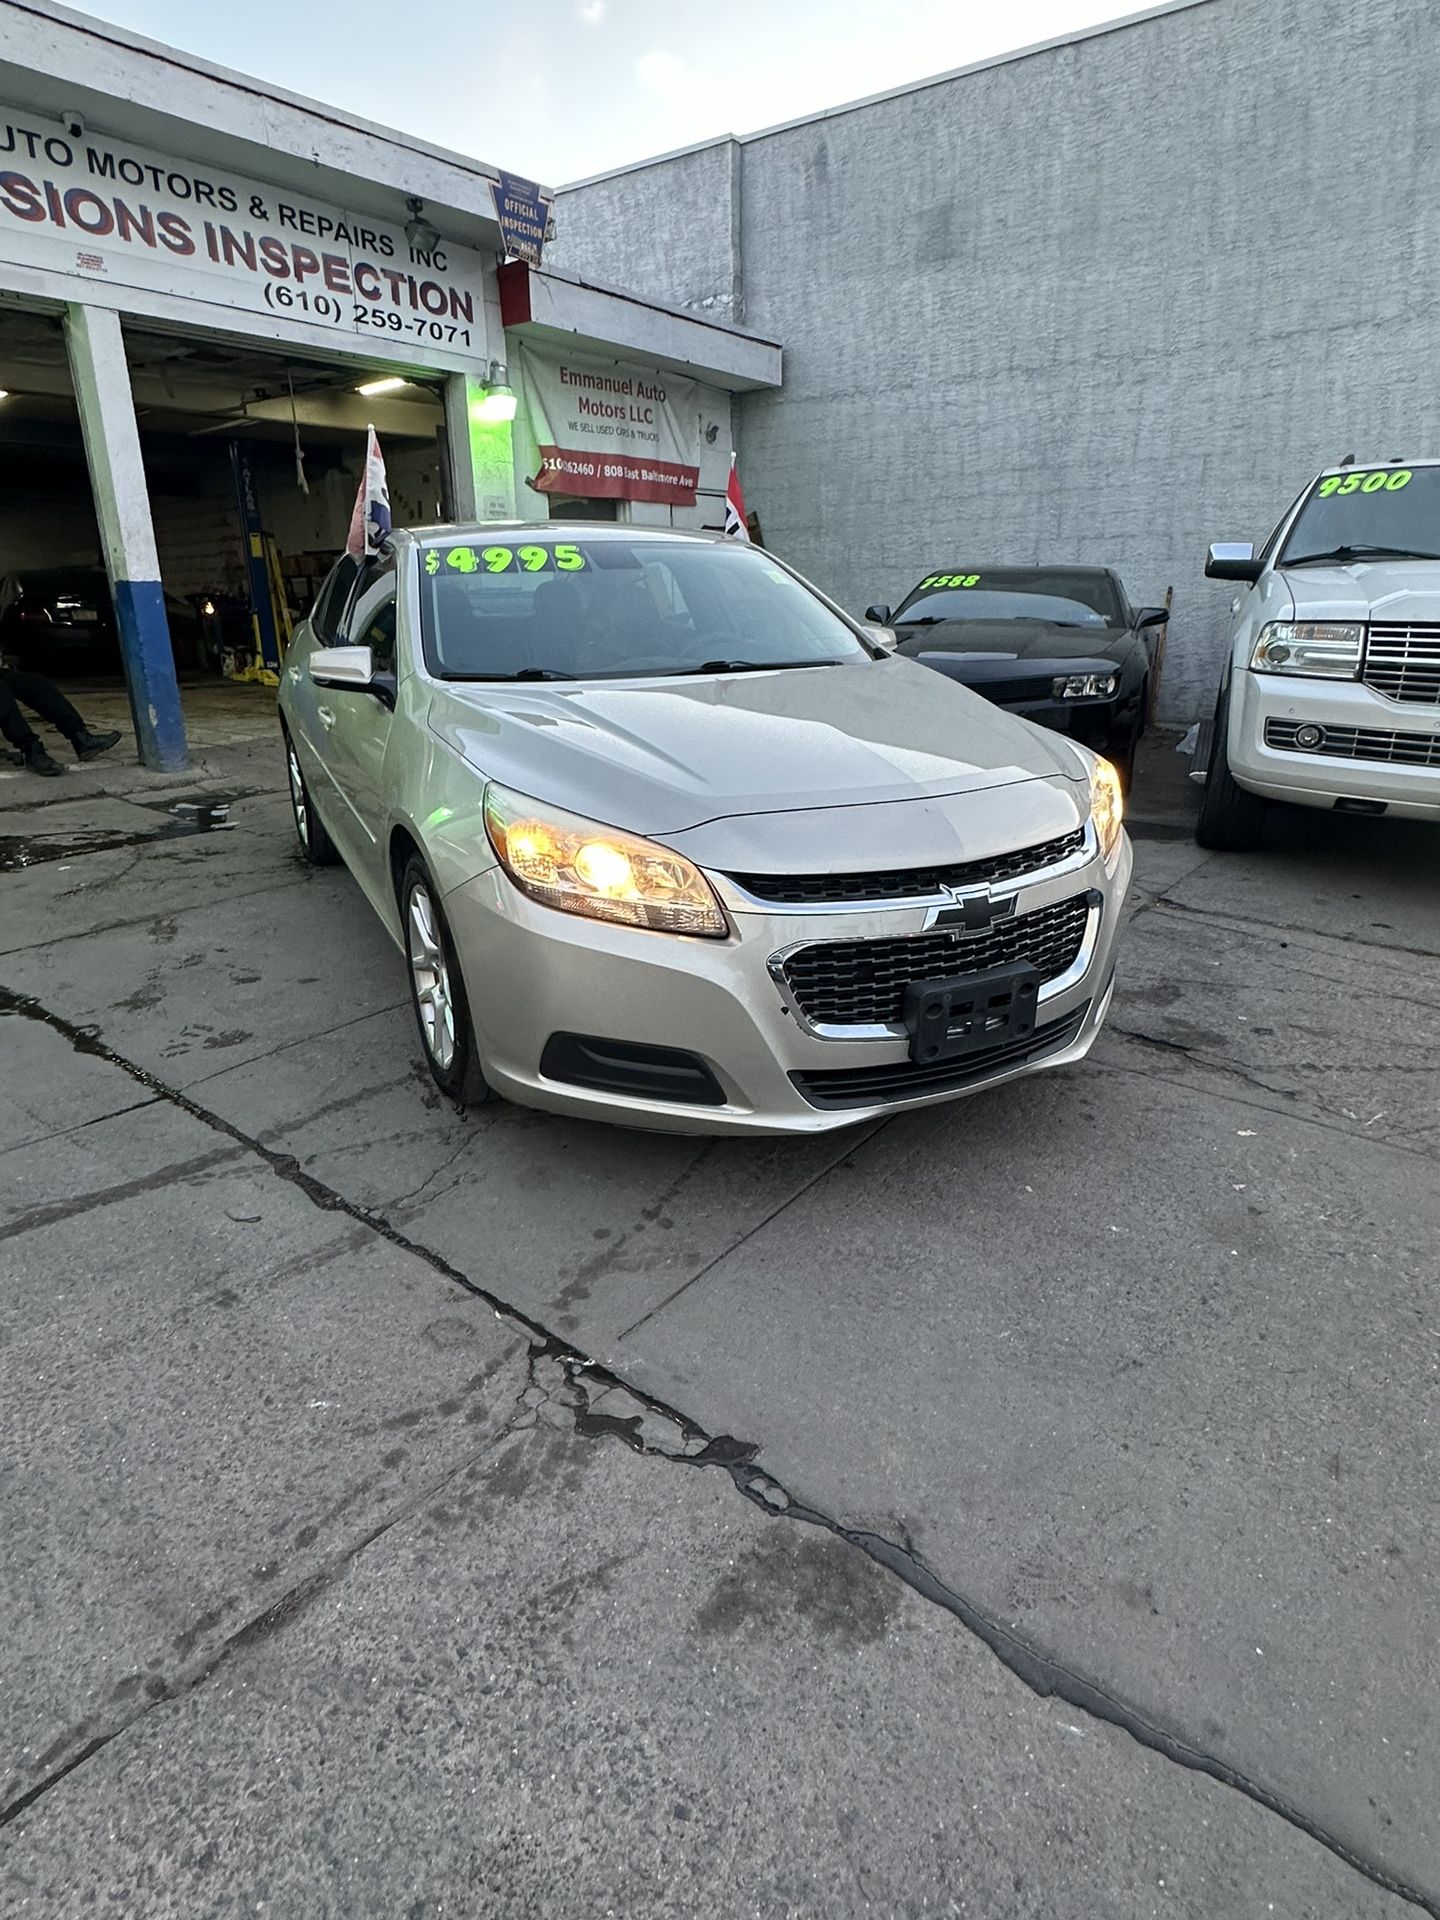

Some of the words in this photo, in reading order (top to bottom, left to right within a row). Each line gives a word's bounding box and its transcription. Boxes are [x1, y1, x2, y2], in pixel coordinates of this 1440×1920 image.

[87, 147, 238, 212] MOTORS
[249, 195, 269, 221] &
[278, 203, 394, 257] REPAIRS
[409, 247, 448, 272] INC
[504, 197, 539, 221] OFFICIAL
[501, 215, 543, 238] INSPECTION
[0, 171, 196, 256] SIONS
[203, 221, 474, 323] INSPECTION
[264, 281, 342, 323] (610)
[353, 304, 472, 347] 259-7071
[560, 366, 633, 397] Emmanuel
[636, 381, 666, 403] Auto
[578, 396, 626, 420] Motors
[629, 406, 654, 425] LLC
[568, 421, 578, 432] WE
[580, 422, 595, 433] SELL
[596, 424, 615, 436] USED
[616, 426, 630, 438] CARS
[631, 430, 636, 439] &
[637, 430, 660, 443] TRUCKS
[604, 465, 624, 478] 808
[624, 466, 640, 481] East
[641, 468, 679, 486] Baltimore
[679, 475, 694, 488] Ave
[1317, 469, 1414, 498] 9500
[425, 544, 586, 575] $4995
[919, 573, 981, 590] 7588
